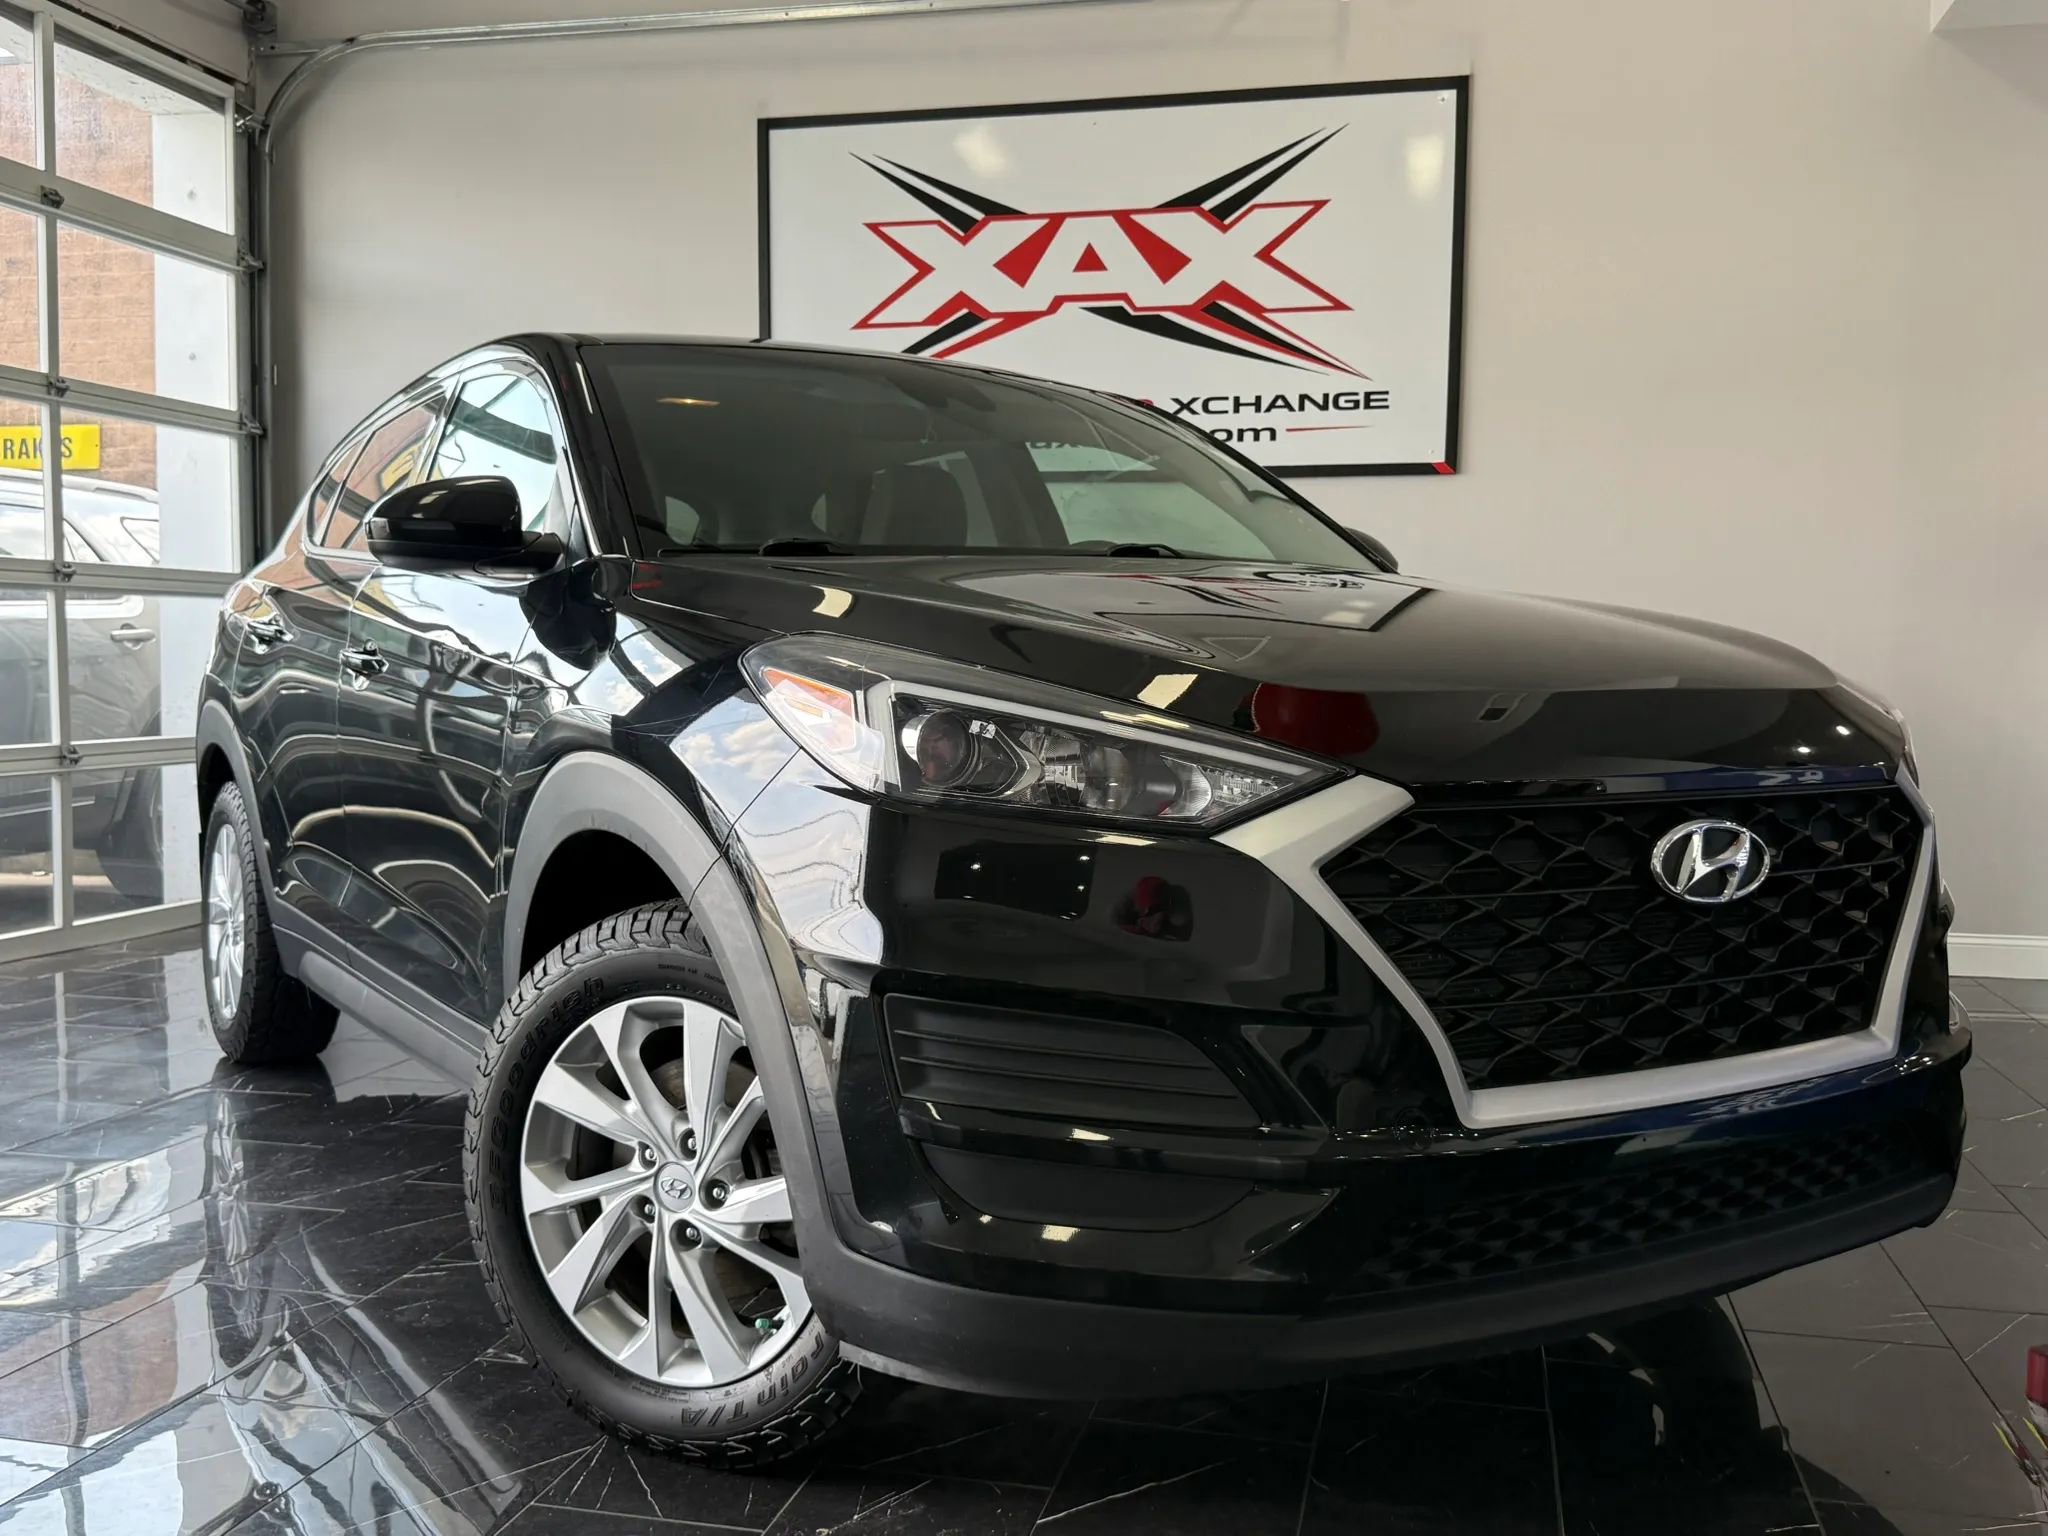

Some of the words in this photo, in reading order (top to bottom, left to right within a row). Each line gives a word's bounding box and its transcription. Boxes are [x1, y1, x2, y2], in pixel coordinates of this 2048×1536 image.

[850, 198, 1355, 331] XAX
[1170, 391, 1390, 415] XCHANGE
[3, 437, 73, 460] RAKS
